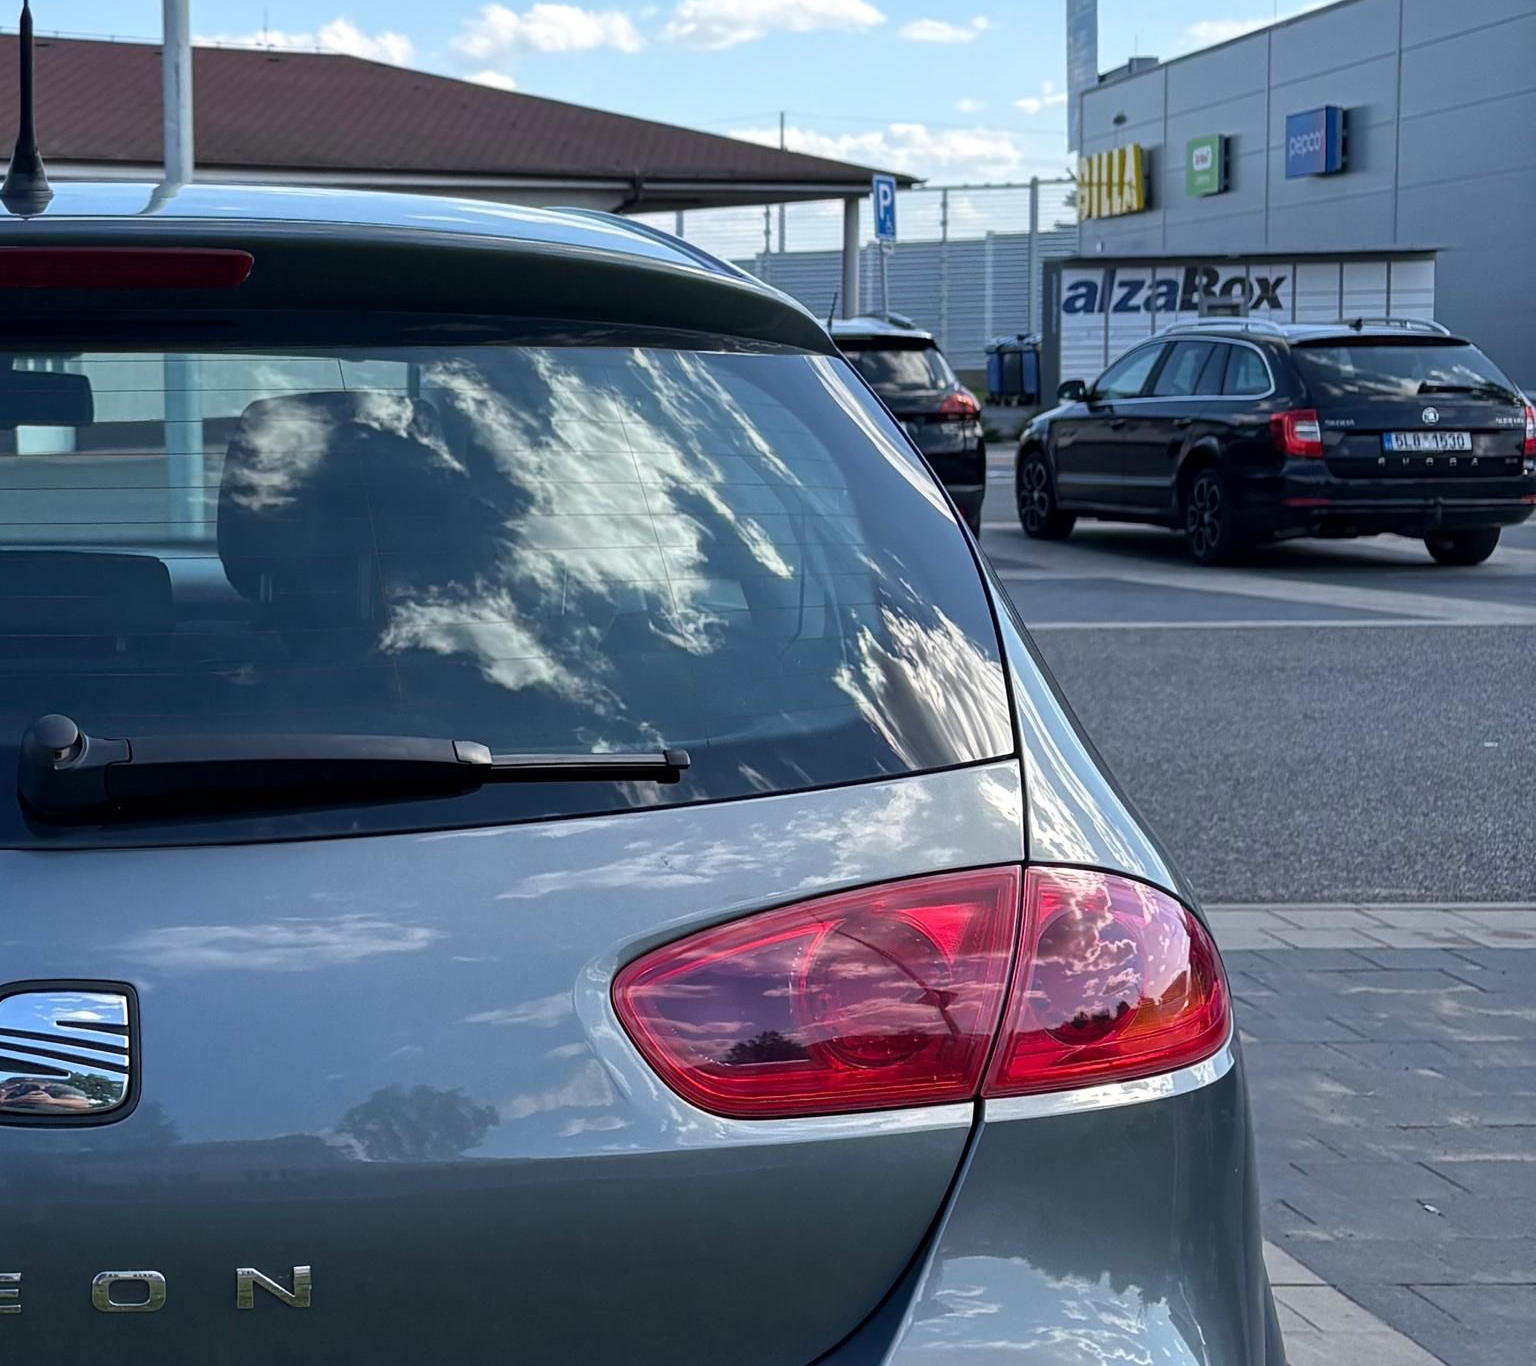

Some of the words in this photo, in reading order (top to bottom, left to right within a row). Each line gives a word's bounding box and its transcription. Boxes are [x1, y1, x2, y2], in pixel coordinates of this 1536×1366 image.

[879, 183, 892, 221] P
[1077, 144, 1138, 221] BILLA
[1062, 266, 1287, 314] alzaBox
